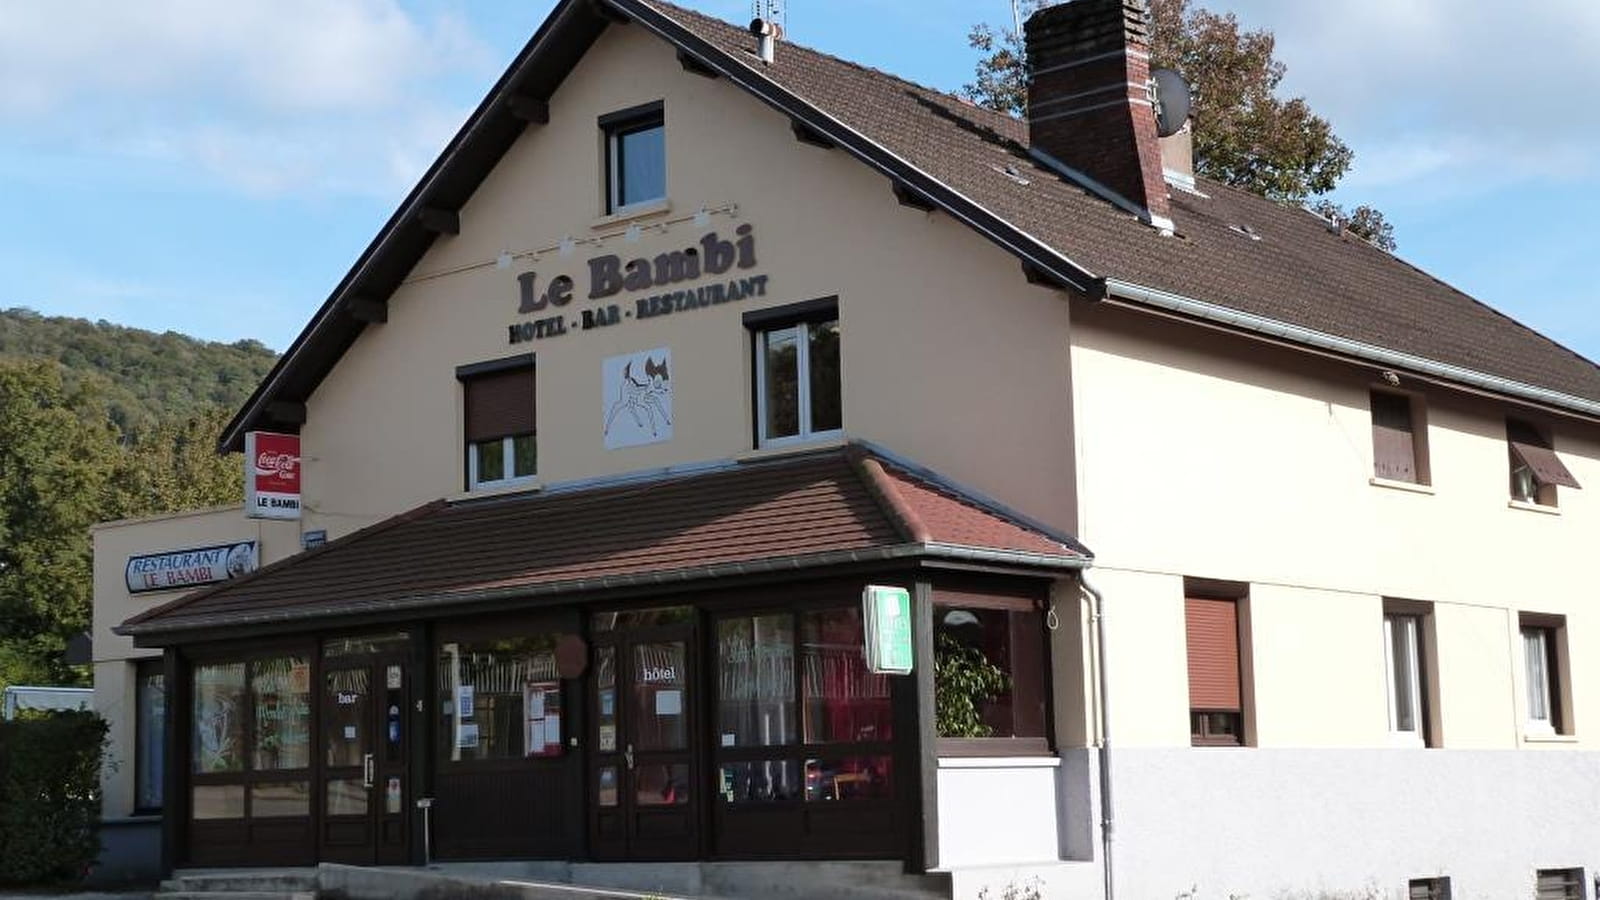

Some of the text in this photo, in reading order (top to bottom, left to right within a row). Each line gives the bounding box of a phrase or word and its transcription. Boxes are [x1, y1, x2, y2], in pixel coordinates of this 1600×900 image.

[517, 223, 758, 314] Le Bambi
[508, 275, 768, 344] HOTEL BAR RESTAURANT
[257, 497, 299, 509] LE BAMBI
[133, 550, 222, 574] RESTAURANT
[143, 567, 213, 588] LE BAMBI
[644, 666, 676, 681] hôtel
[338, 692, 358, 704] bar
